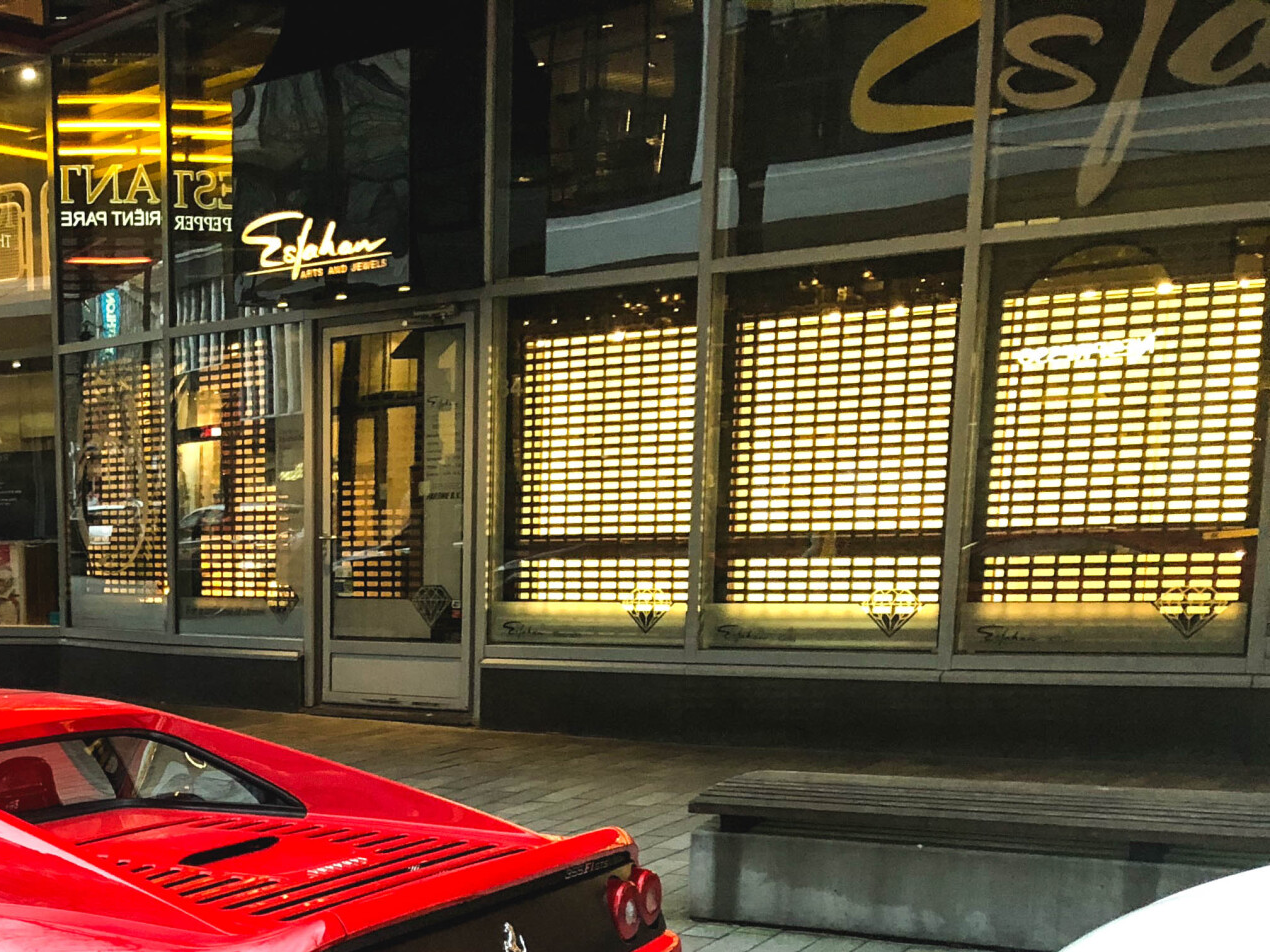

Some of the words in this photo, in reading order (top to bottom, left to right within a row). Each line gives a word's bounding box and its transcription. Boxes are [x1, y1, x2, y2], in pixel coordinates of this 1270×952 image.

[299, 267, 324, 280] ARTS
[327, 264, 348, 276] AND
[350, 258, 388, 273] JEWELS
